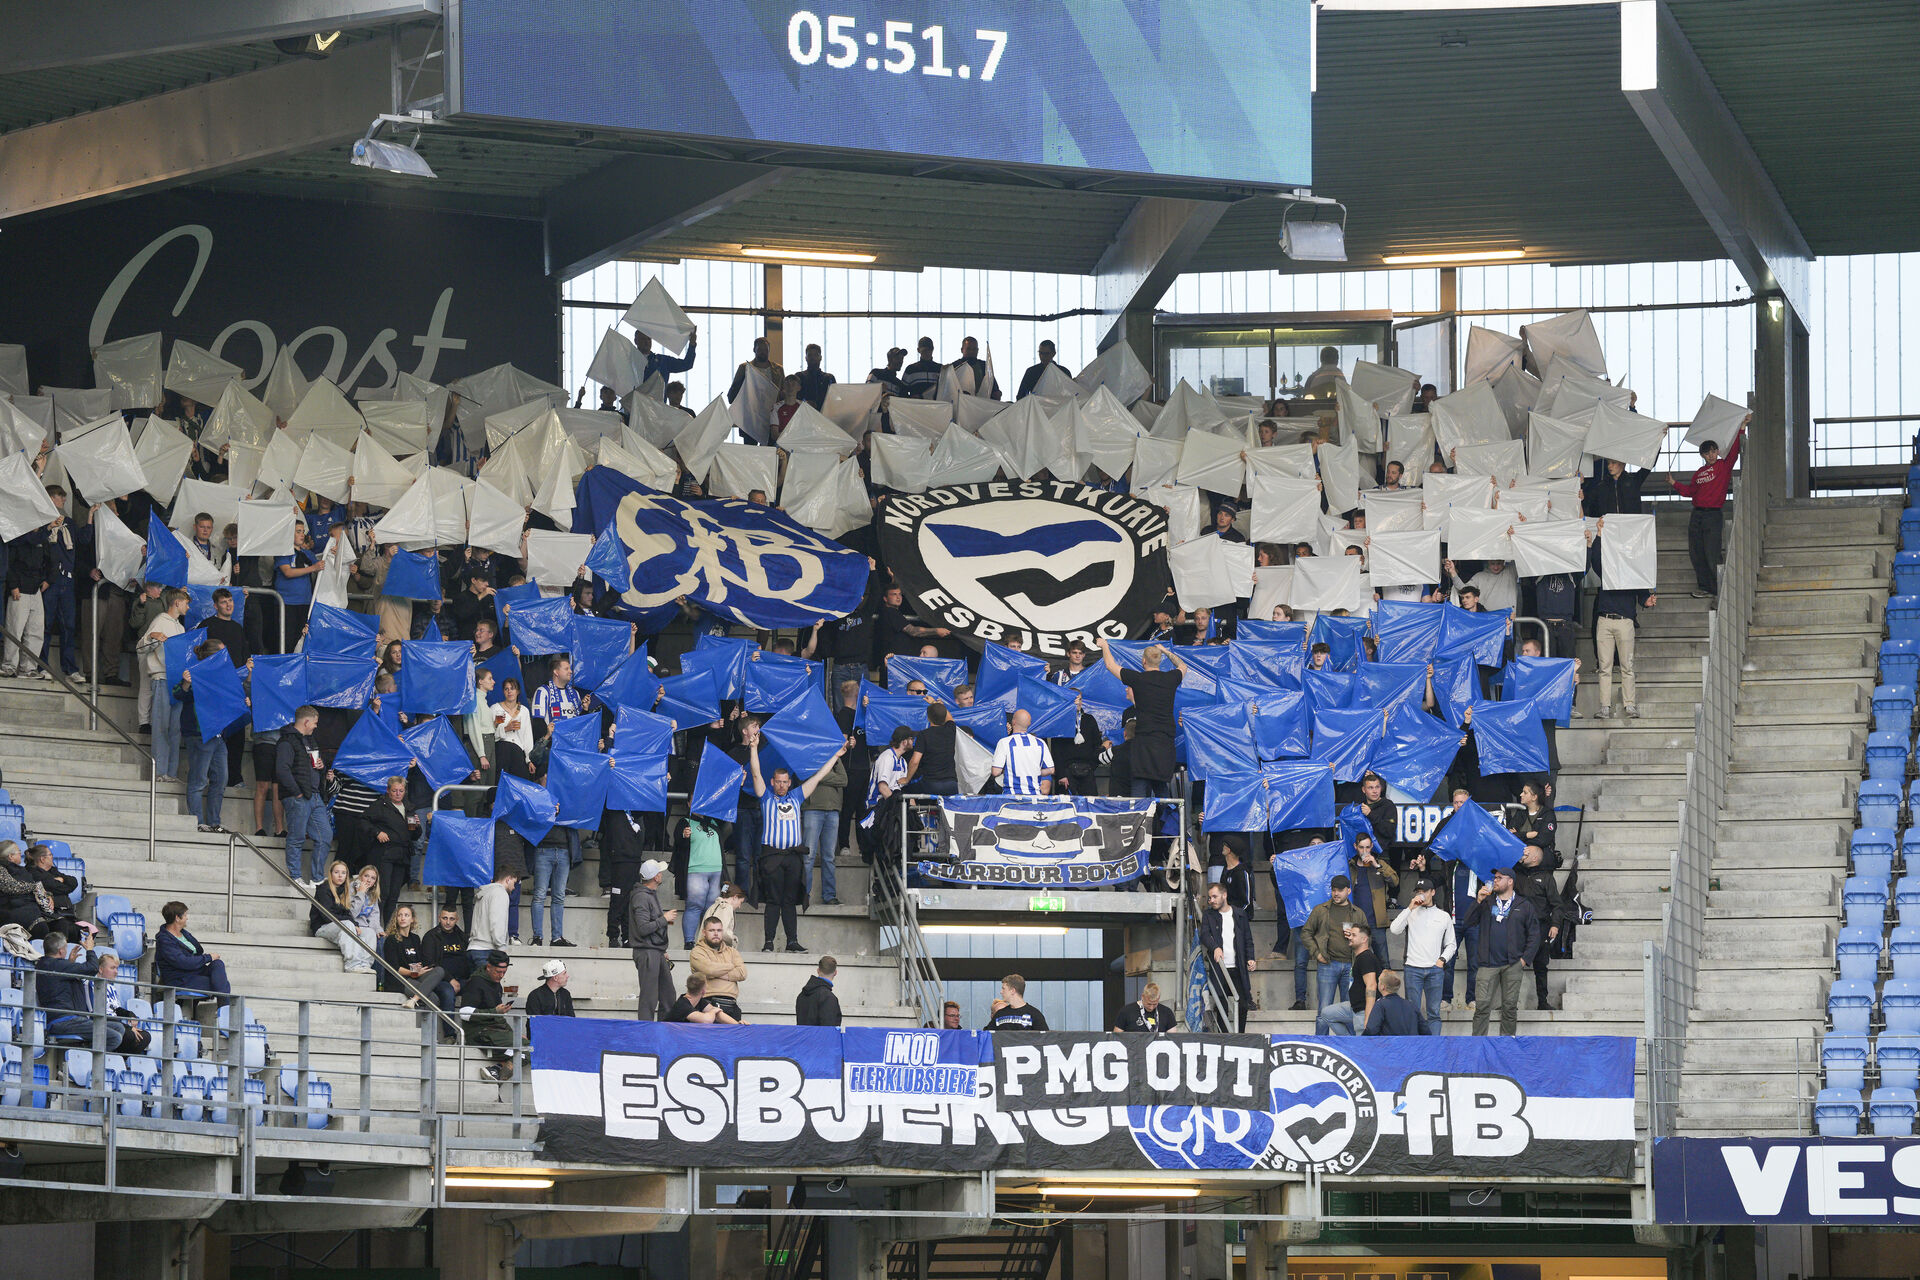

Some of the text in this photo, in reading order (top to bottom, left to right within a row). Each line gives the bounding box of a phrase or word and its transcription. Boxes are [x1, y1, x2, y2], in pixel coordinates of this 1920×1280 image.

[788, 10, 1008, 81] 05:51.7
[885, 481, 1168, 557] NORDVESTKURVE
[919, 588, 1128, 656] ESBJERG
[930, 855, 1140, 884] HARBOUR BOYS
[884, 1032, 940, 1066] IMOD
[1002, 1041, 1265, 1097] PMG OUT
[850, 1065, 977, 1097] FLERKLUBSEJERE
[1396, 1073, 1531, 1157] fB
